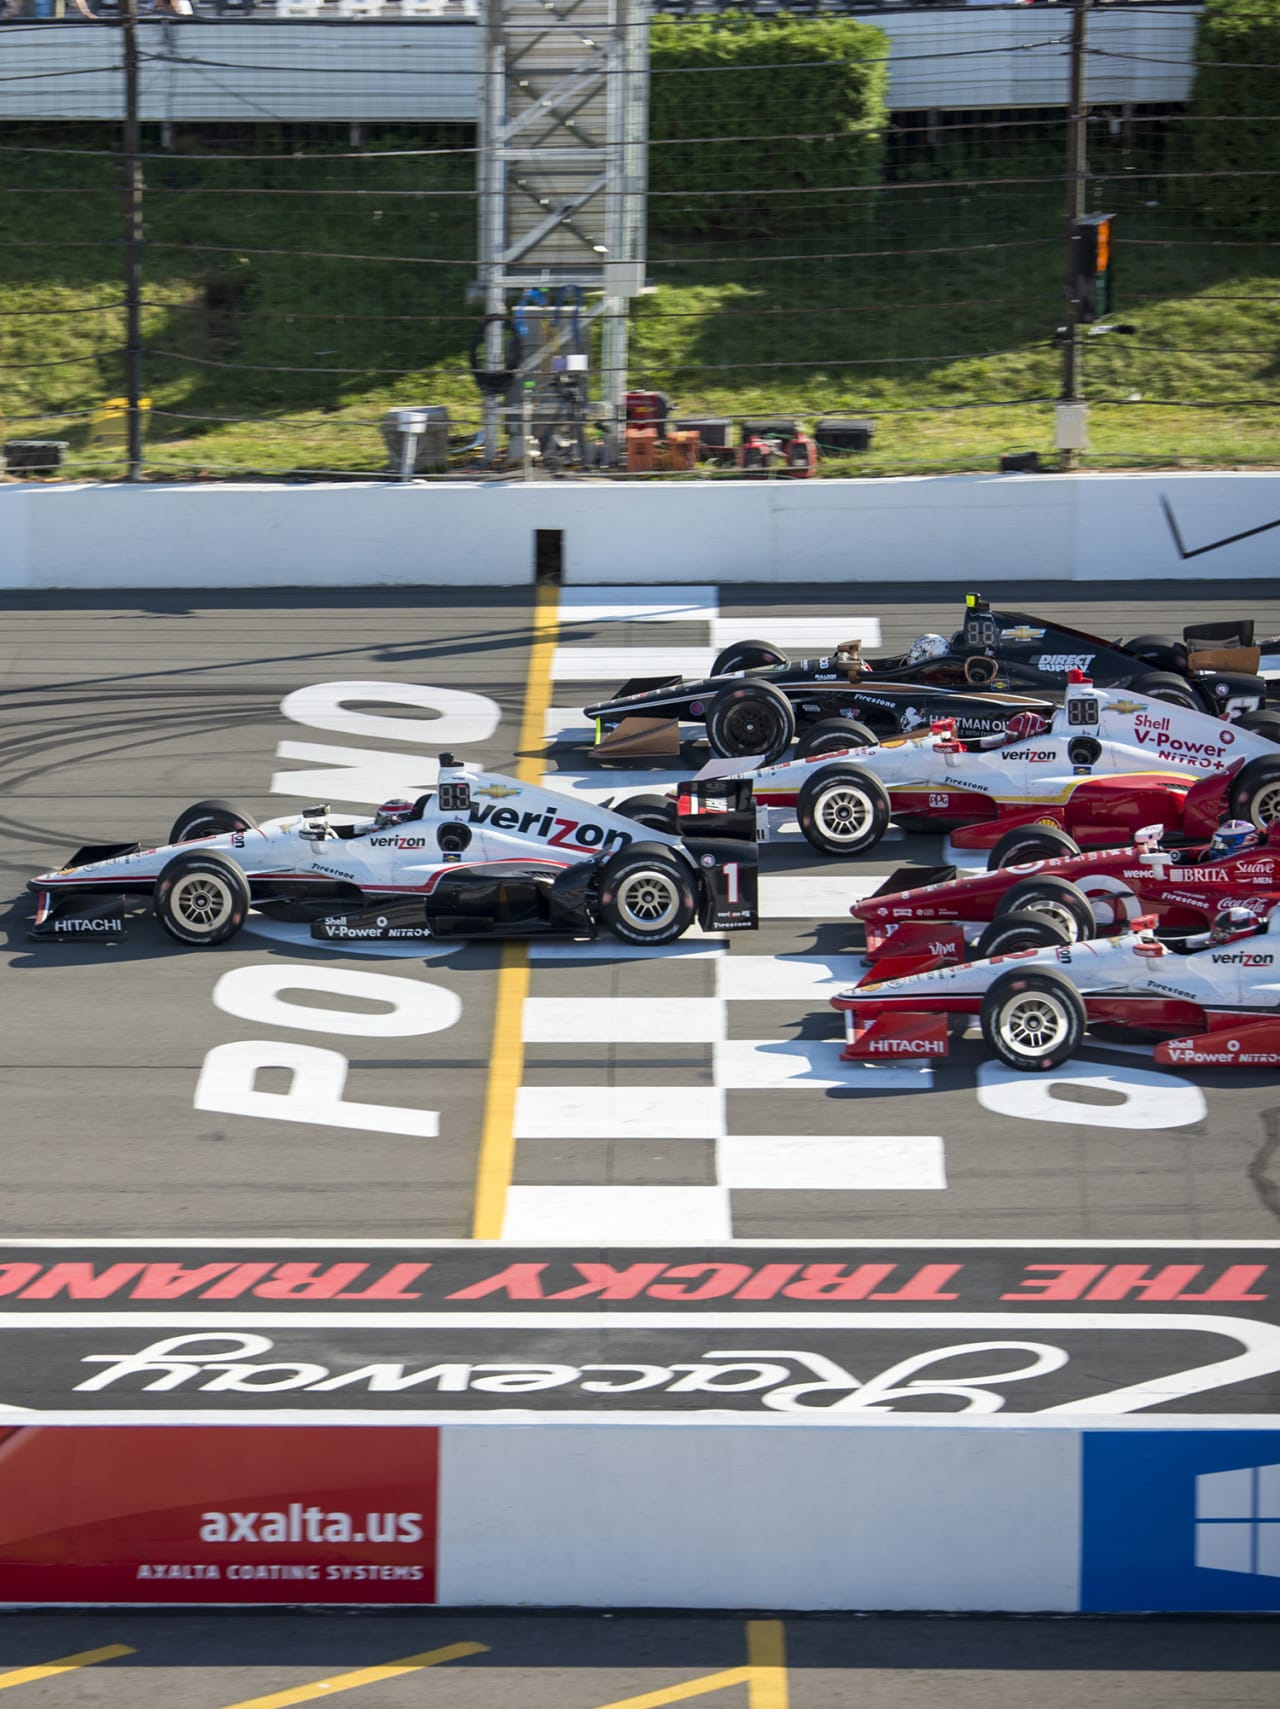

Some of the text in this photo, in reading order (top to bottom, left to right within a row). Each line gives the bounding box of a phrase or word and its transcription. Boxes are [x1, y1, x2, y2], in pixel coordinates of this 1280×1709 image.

[1039, 655, 1096, 665] DIRECT
[853, 693, 897, 708] Firestone
[1134, 714, 1170, 731] Shell
[1134, 728, 1226, 758] V-Power
[1001, 747, 1056, 763] verizon
[944, 776, 989, 792] Firestone
[470, 801, 633, 855] verizon
[370, 835, 426, 850] verizon
[311, 863, 356, 880] Firestone
[1234, 858, 1275, 873] Suave
[723, 862, 738, 903] 1
[1184, 869, 1229, 882] BRITA
[1252, 876, 1273, 884] MEN
[1162, 892, 1210, 909] Firestone
[55, 919, 122, 932] HITACHI
[325, 916, 347, 925] Shell
[325, 926, 384, 937] V-Power
[1212, 951, 1274, 967] verizon
[1147, 980, 1197, 1000] Firestone
[869, 1039, 944, 1053] HITACHI
[1167, 1040, 1194, 1049] Shell
[1168, 1049, 1235, 1062] V-Power
[447, 1263, 963, 1302] TRICKY
[1001, 1263, 1269, 1302] THE
[199, 1503, 424, 1543] axalta.us
[136, 1564, 424, 1580] AXALTA COATING SYSTEMS
